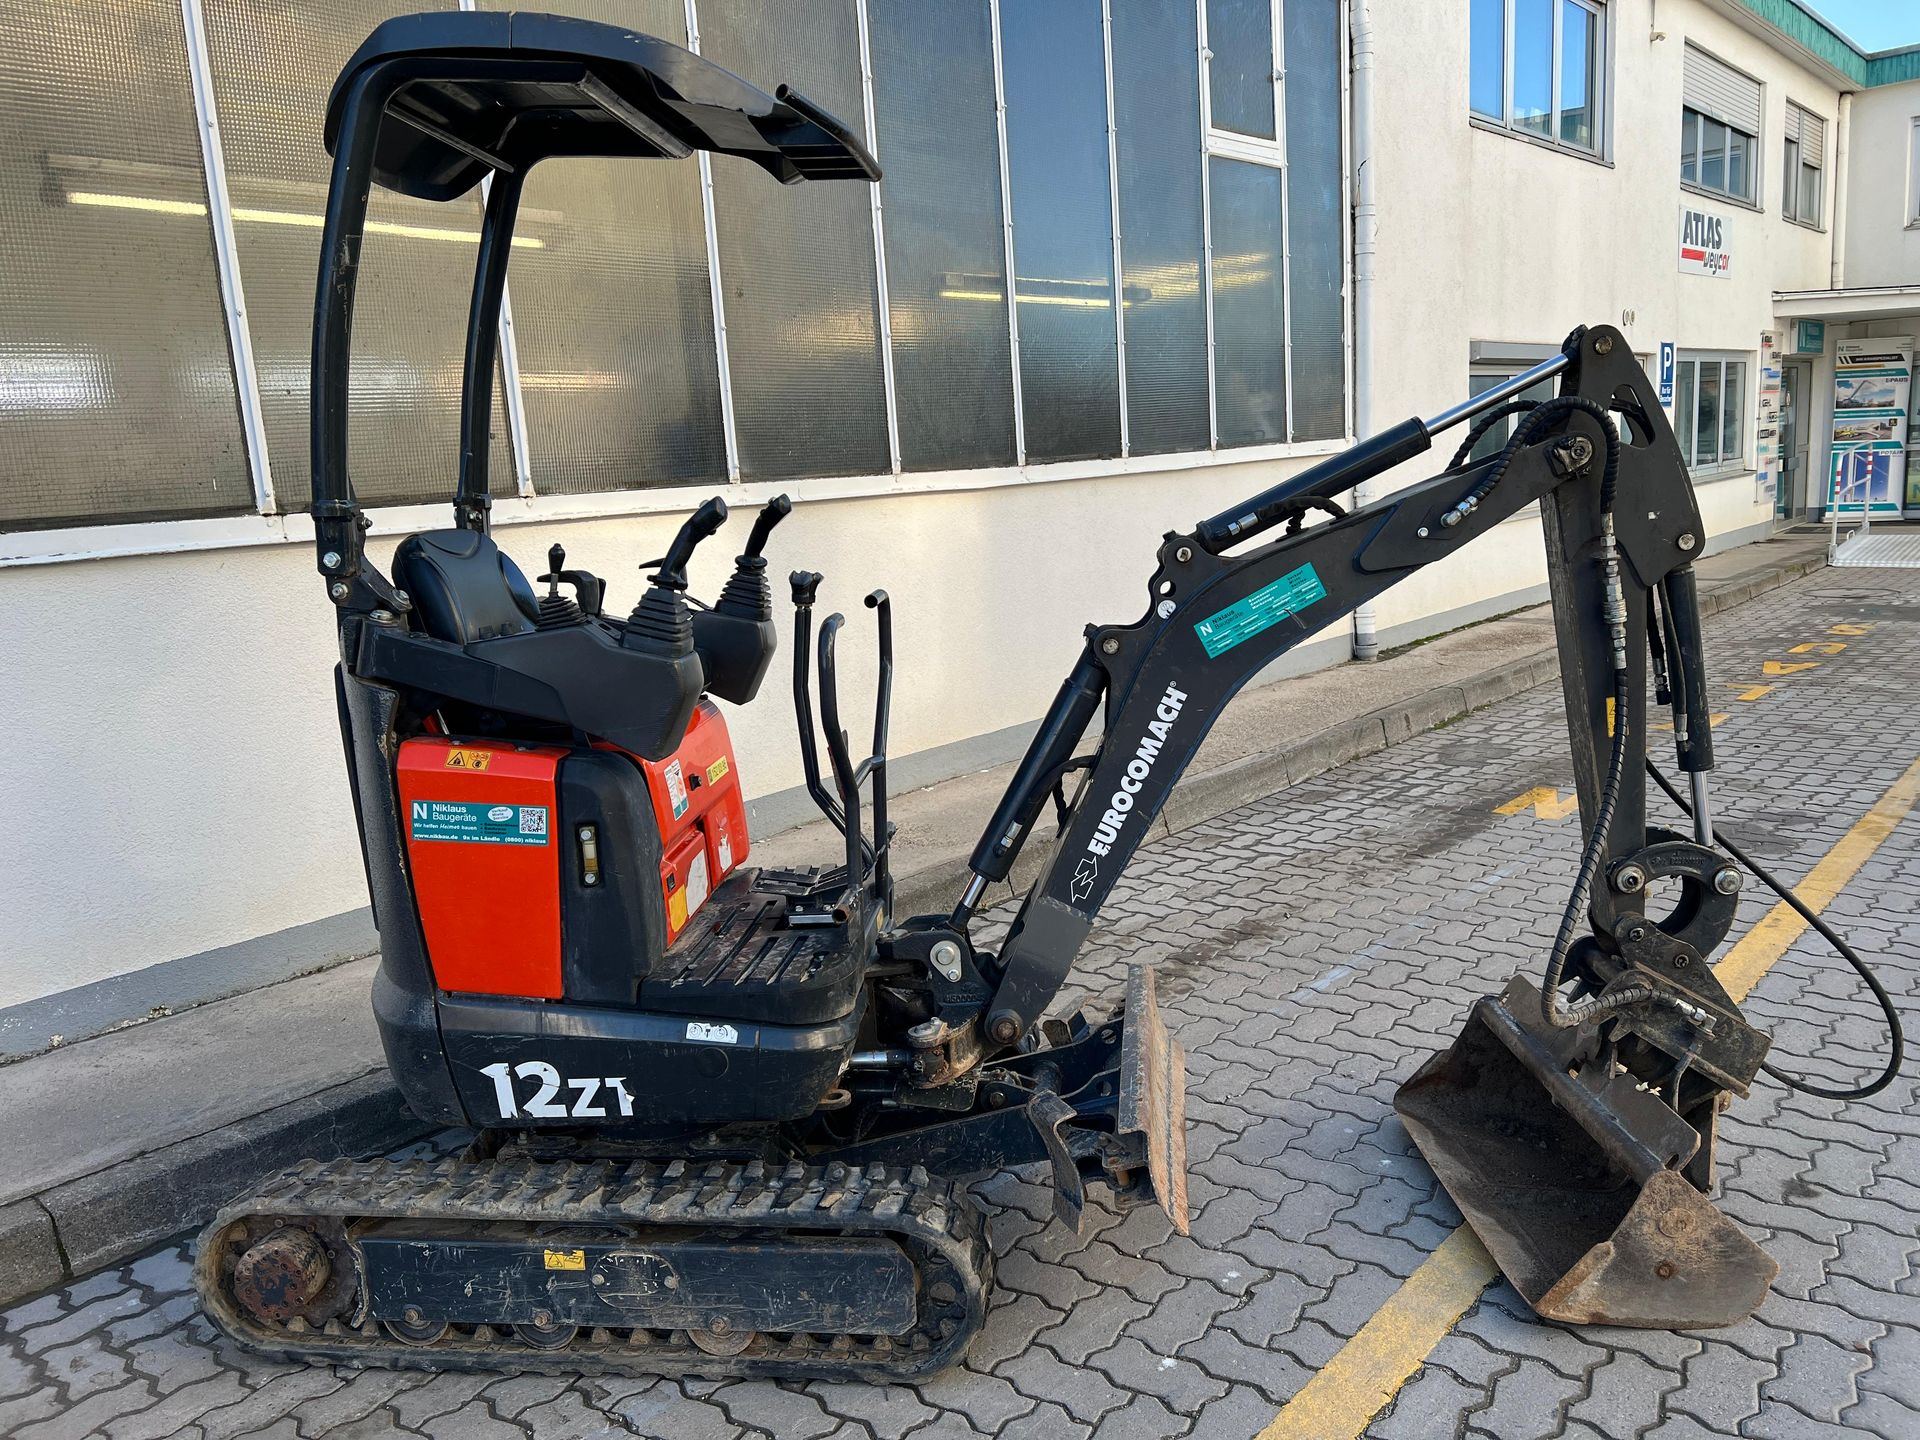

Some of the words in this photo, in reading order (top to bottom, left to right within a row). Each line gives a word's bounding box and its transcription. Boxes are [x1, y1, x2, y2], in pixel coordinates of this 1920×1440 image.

[1682, 210, 1723, 249] ATLAS
[1663, 346, 1672, 380] P
[1212, 610, 1235, 624] Niklaus
[1200, 622, 1213, 636] N
[413, 803, 428, 820] N
[432, 804, 467, 813] Niklaus
[432, 812, 477, 823] Baugeräte
